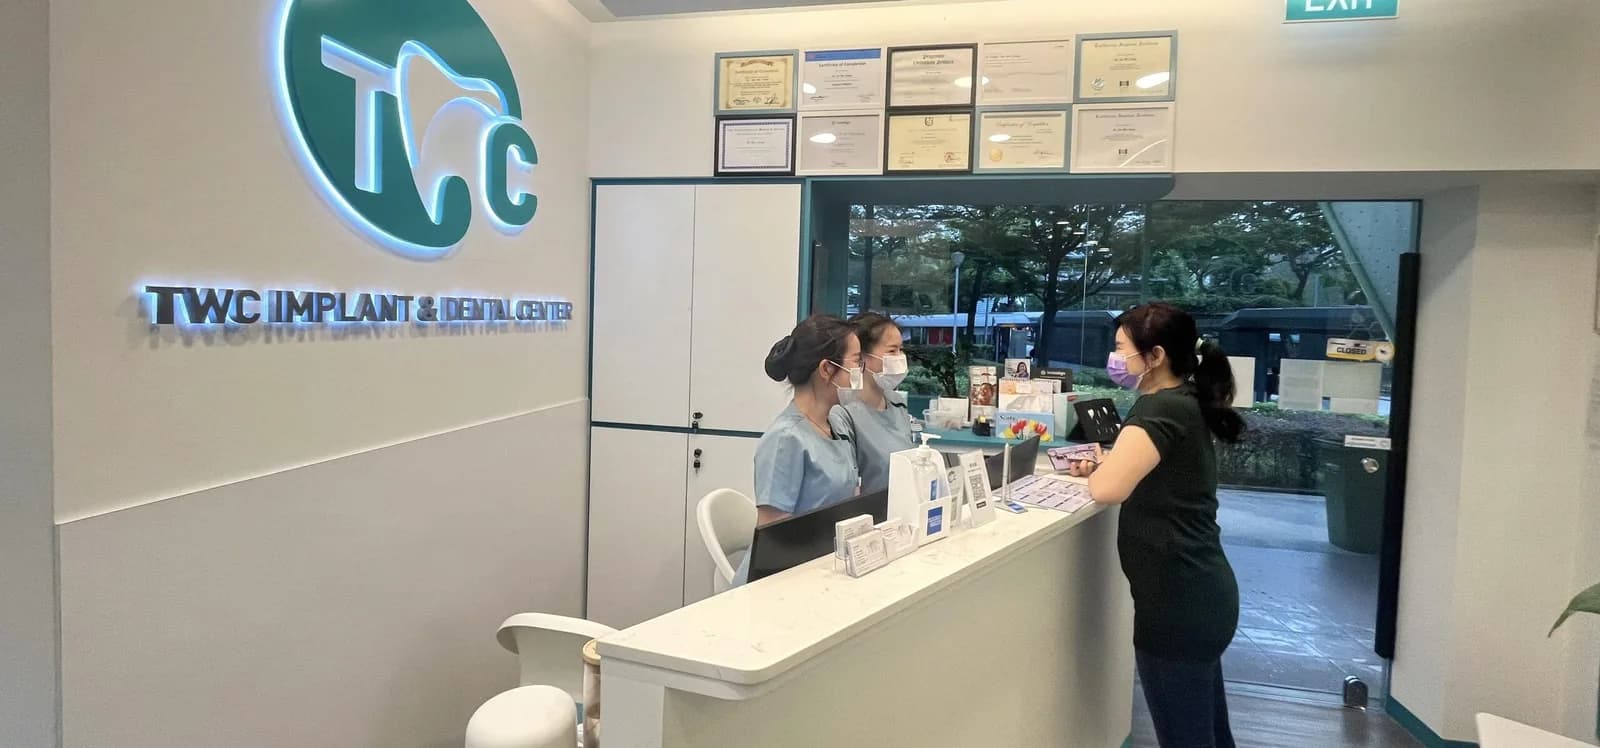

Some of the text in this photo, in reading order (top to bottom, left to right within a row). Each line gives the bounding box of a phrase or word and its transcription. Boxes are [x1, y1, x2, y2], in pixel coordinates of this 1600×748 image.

[145, 286, 573, 324] TWC IMPLANT & DENTAL CENTER
[1336, 346, 1367, 355] CLOSED
